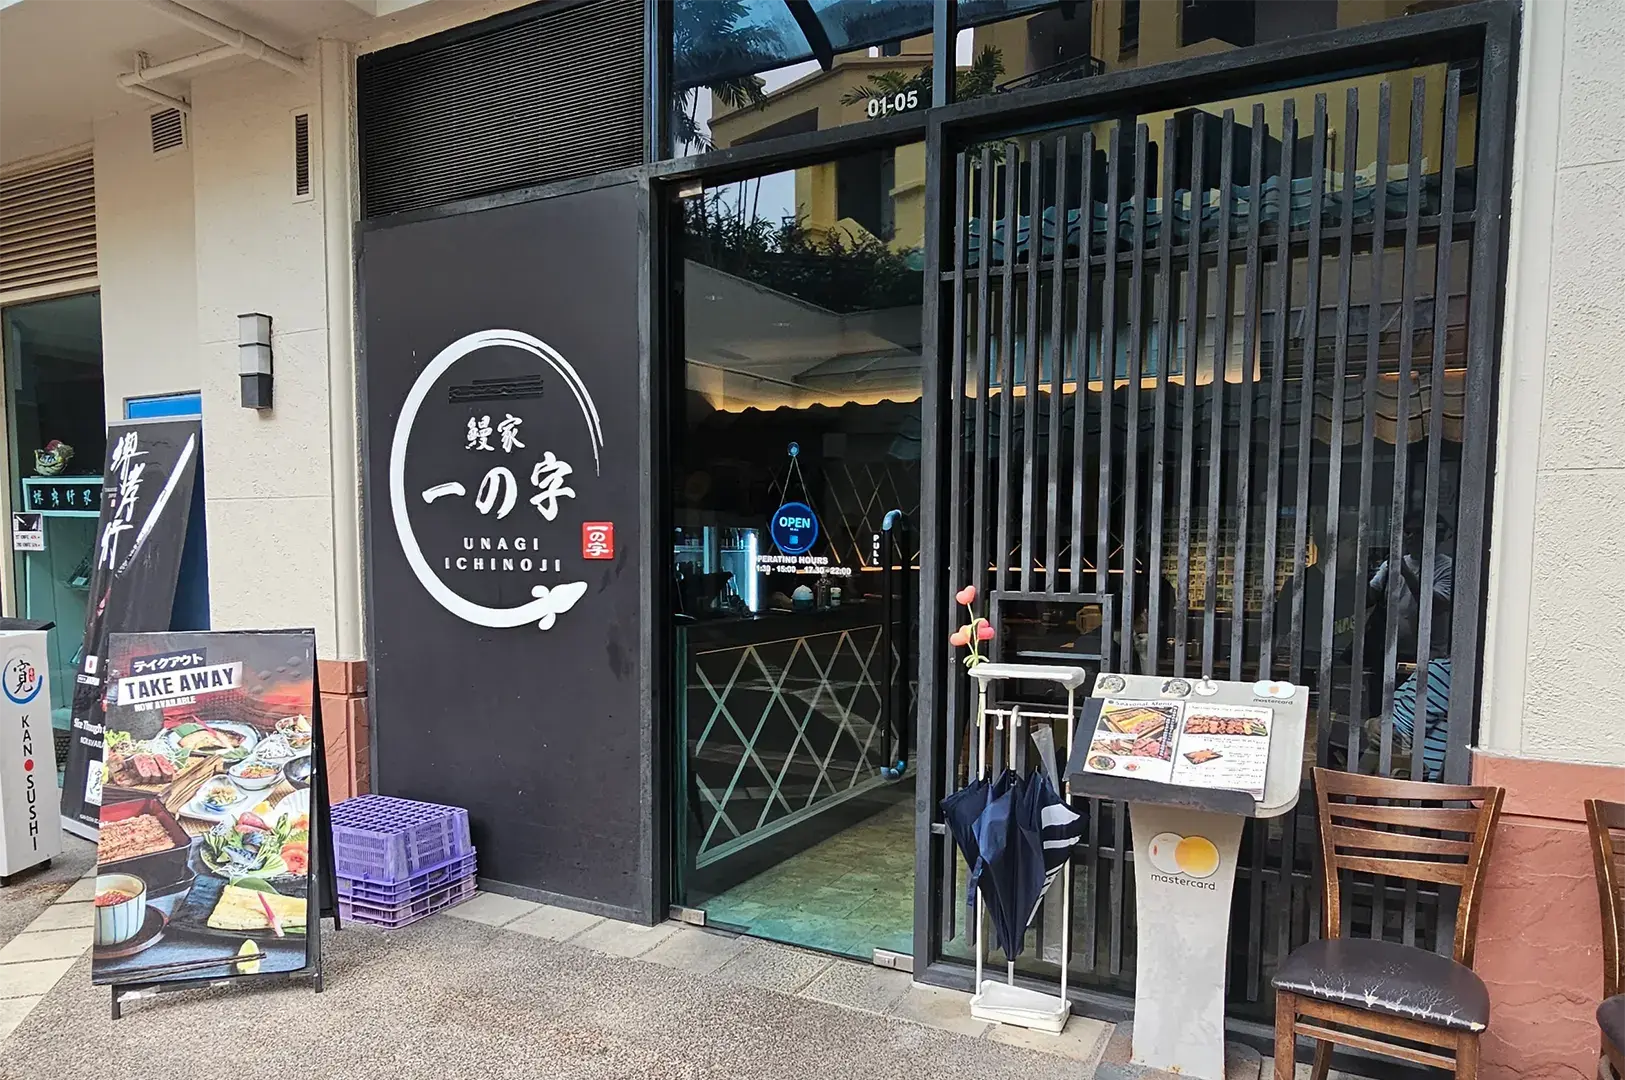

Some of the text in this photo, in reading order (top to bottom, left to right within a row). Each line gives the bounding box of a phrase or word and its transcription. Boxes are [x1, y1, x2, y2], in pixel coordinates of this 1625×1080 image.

[867, 91, 918, 117] 01-05
[465, 413, 526, 453] 鰻家
[421, 451, 576, 521] 一の字
[779, 516, 811, 528] OPEN
[463, 537, 540, 551] UNAGI
[585, 525, 610, 556] 一の字
[872, 534, 880, 565] PULL
[445, 557, 561, 573] ICHINOJI
[755, 555, 829, 565] PERATING HOURS
[133, 653, 204, 673] テイクアウト
[125, 667, 234, 700] TAKE AWAY
[134, 696, 197, 713] NOW AVAILABLE
[1252, 698, 1294, 706] mastercard
[21, 715, 33, 757] KAN
[26, 774, 39, 851] SUSHI
[1150, 873, 1216, 891] mastercard
